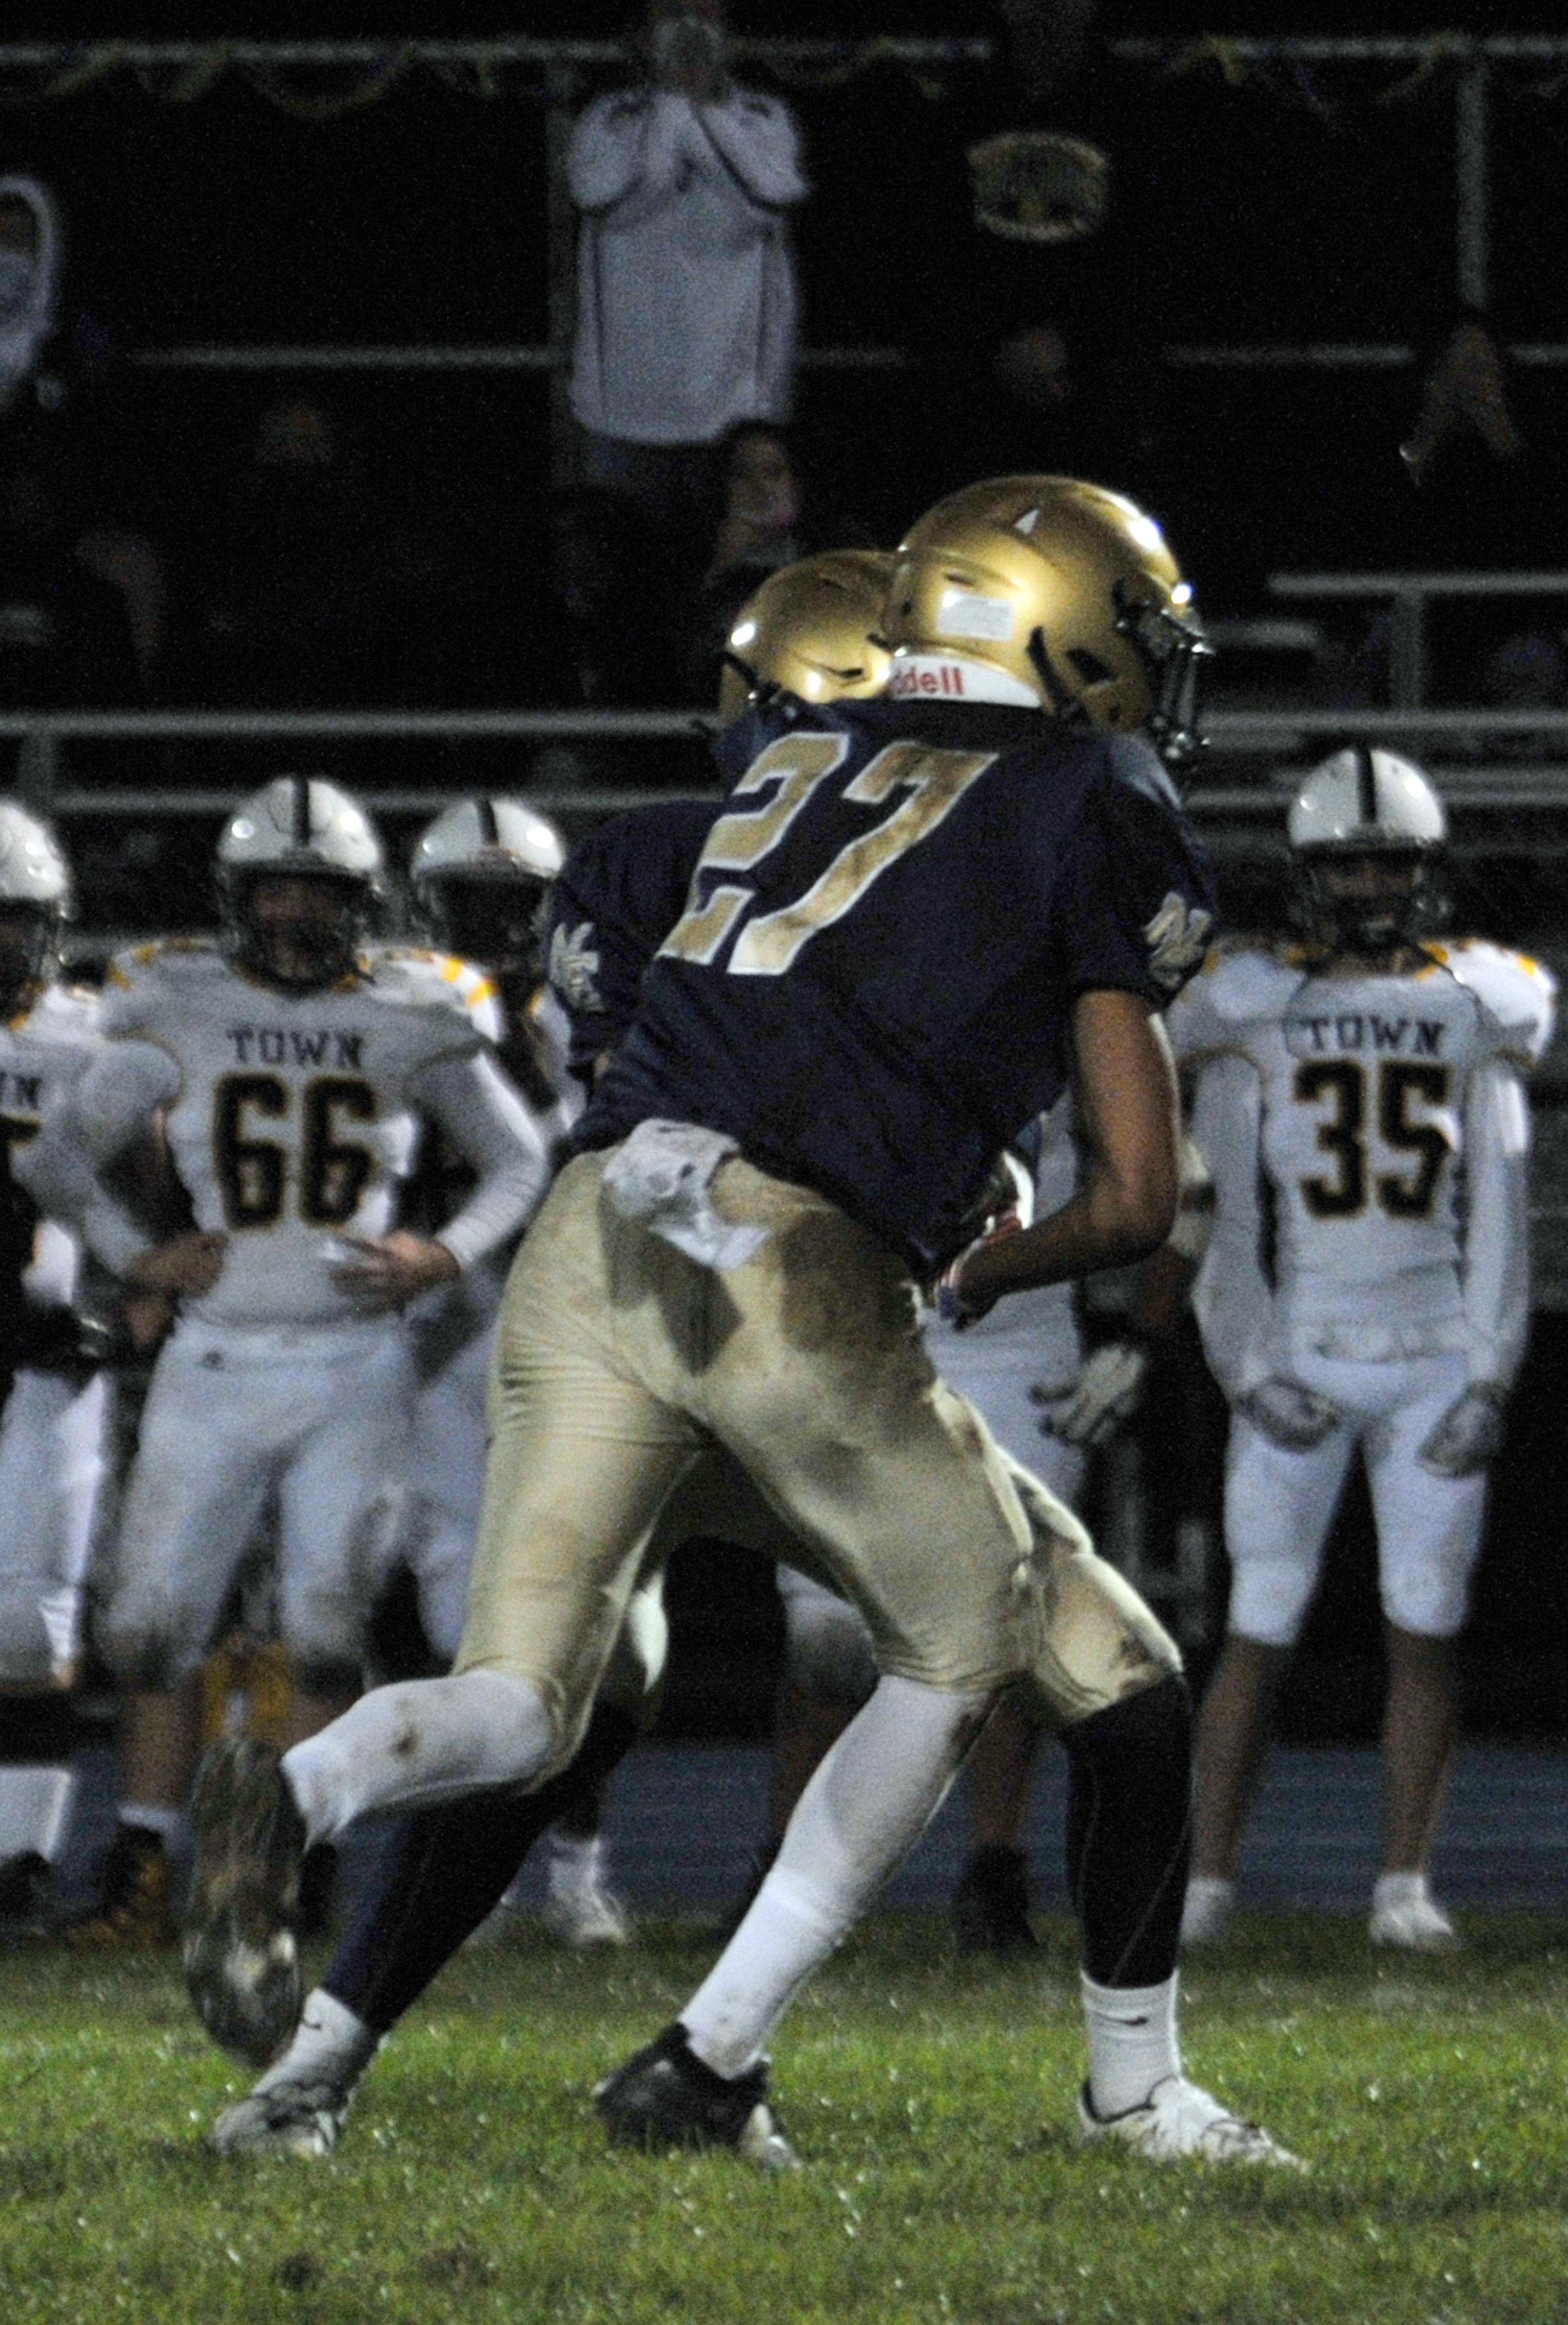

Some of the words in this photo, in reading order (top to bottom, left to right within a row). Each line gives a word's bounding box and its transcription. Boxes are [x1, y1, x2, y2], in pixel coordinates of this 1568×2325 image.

[655, 731, 999, 975] 27
[227, 1023, 363, 1069] TOWN
[1307, 1014, 1445, 1054] TOWN
[212, 1070, 383, 1231] 66
[1292, 1056, 1452, 1220] 35
